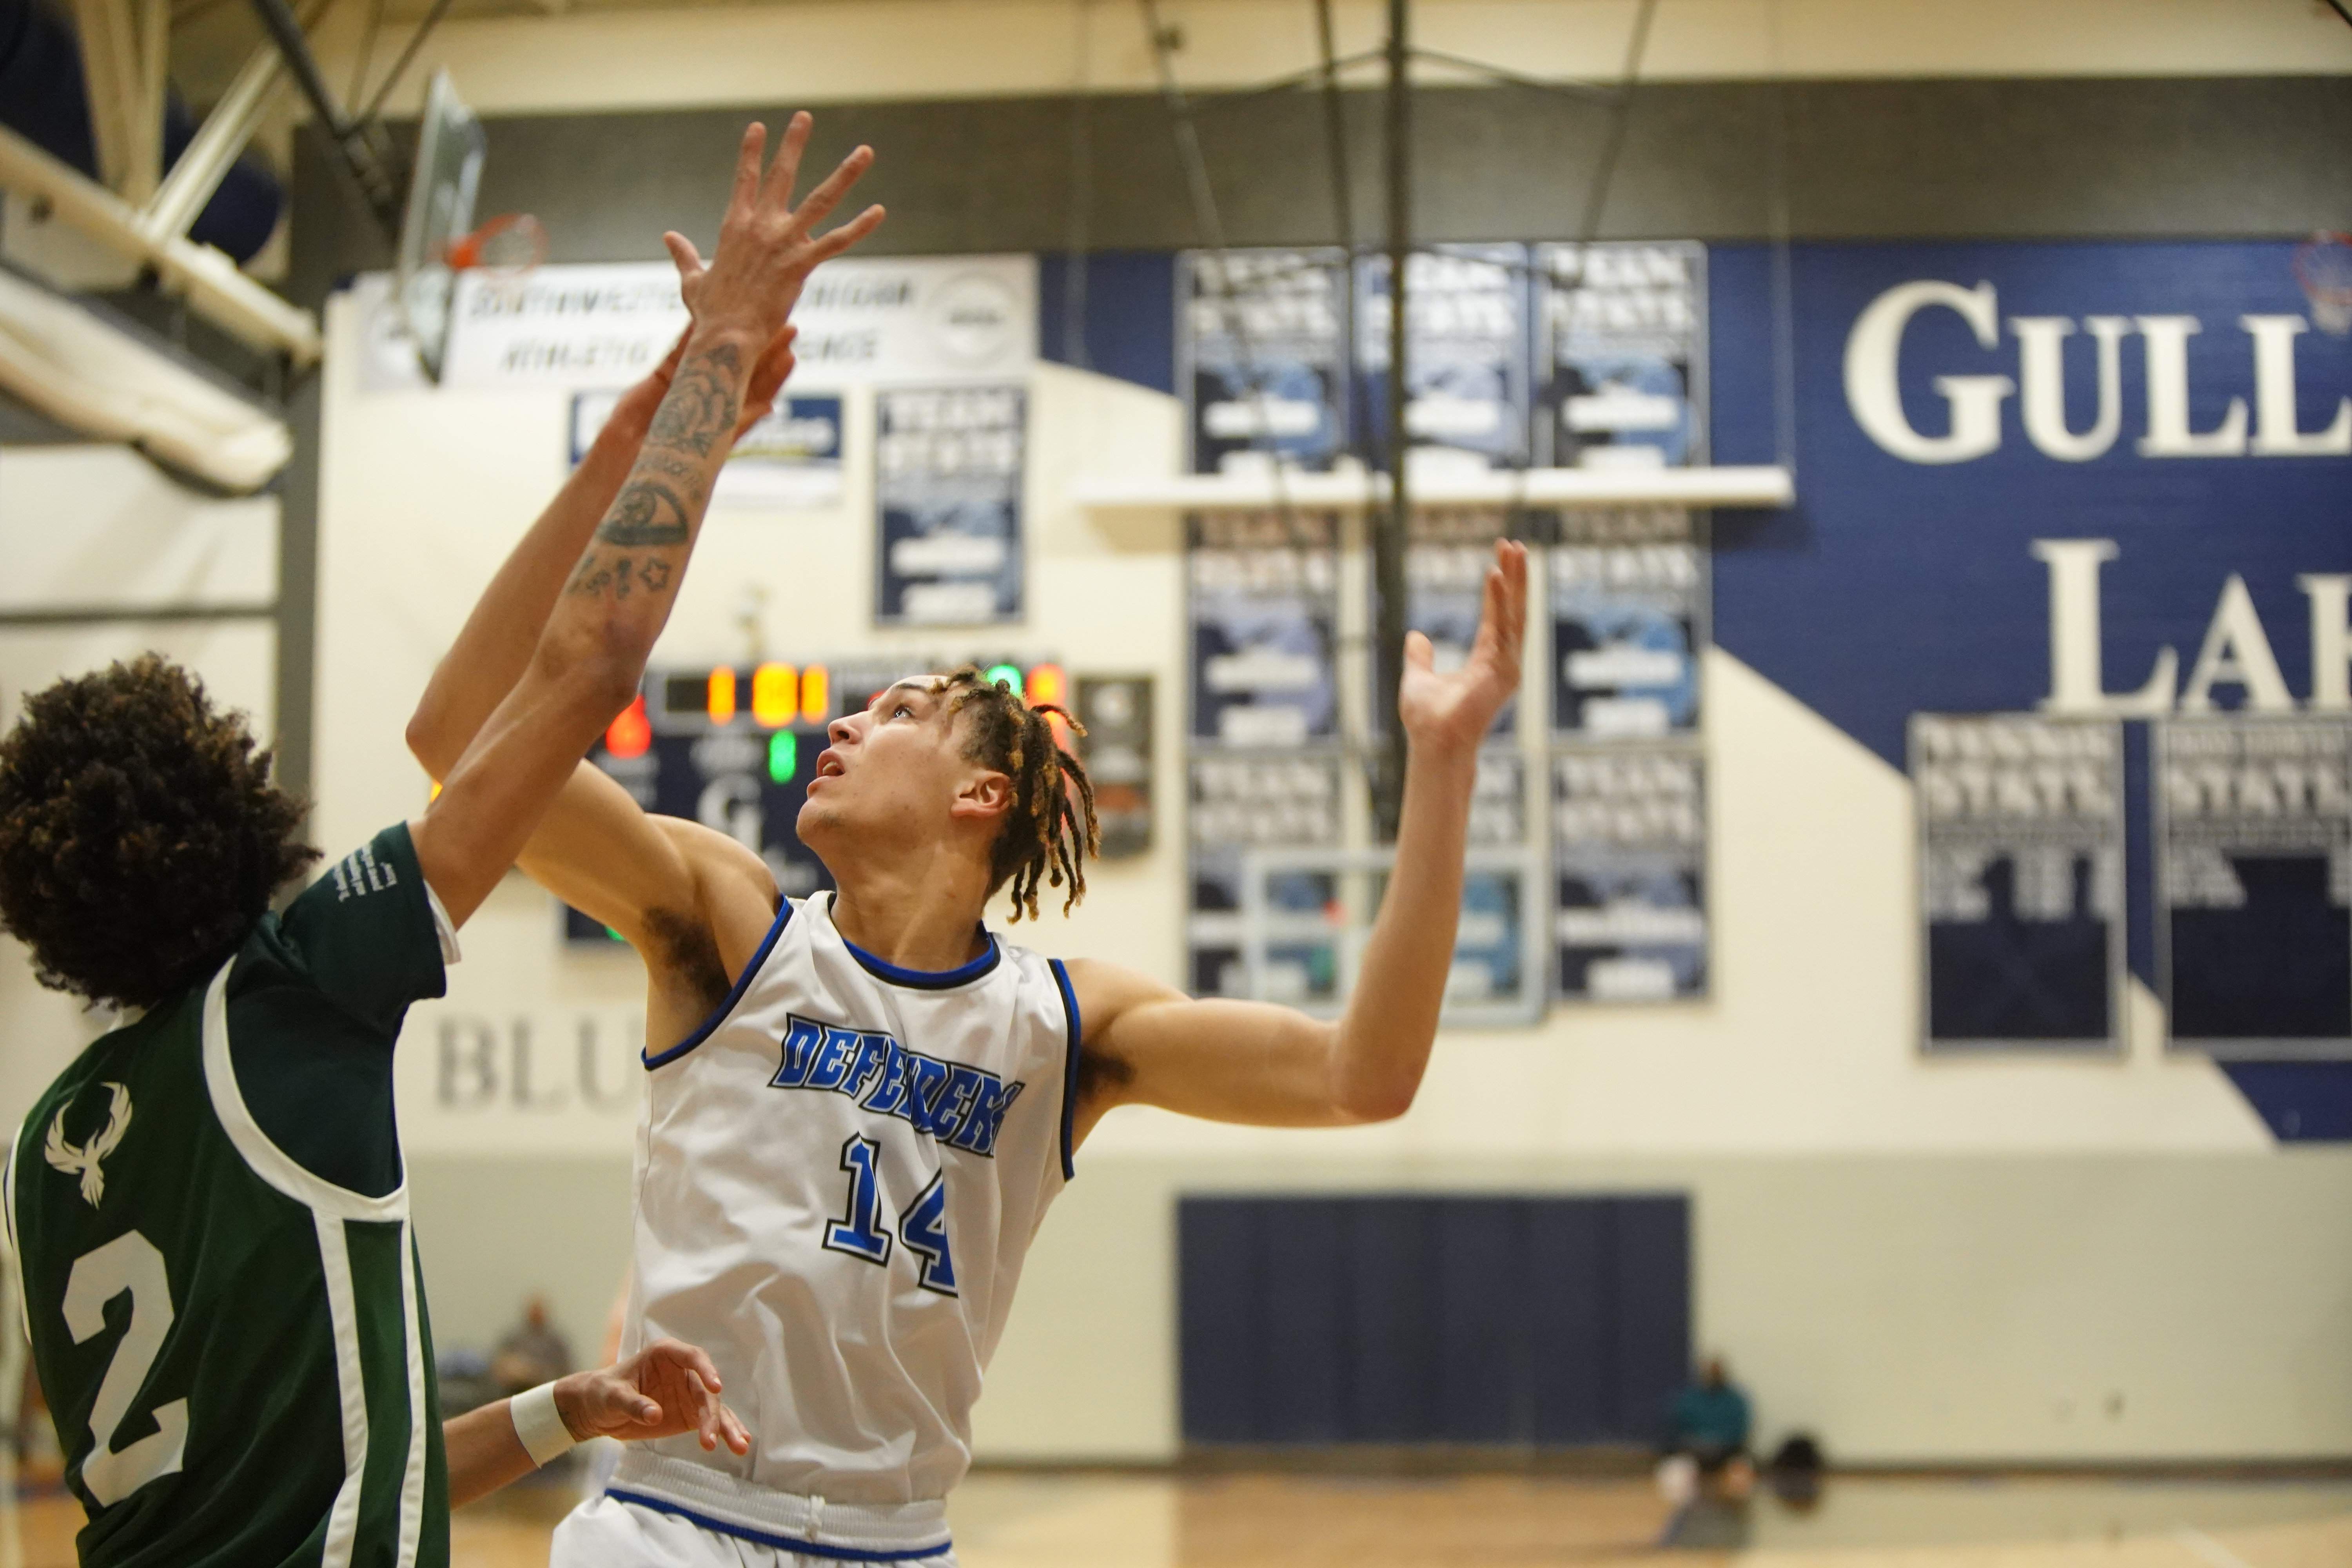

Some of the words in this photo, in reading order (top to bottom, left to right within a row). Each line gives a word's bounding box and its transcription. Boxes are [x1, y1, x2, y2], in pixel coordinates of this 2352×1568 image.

[1841, 278, 2352, 466] GULL
[822, 1131, 959, 1298] 14
[61, 1229, 190, 1509] 2
